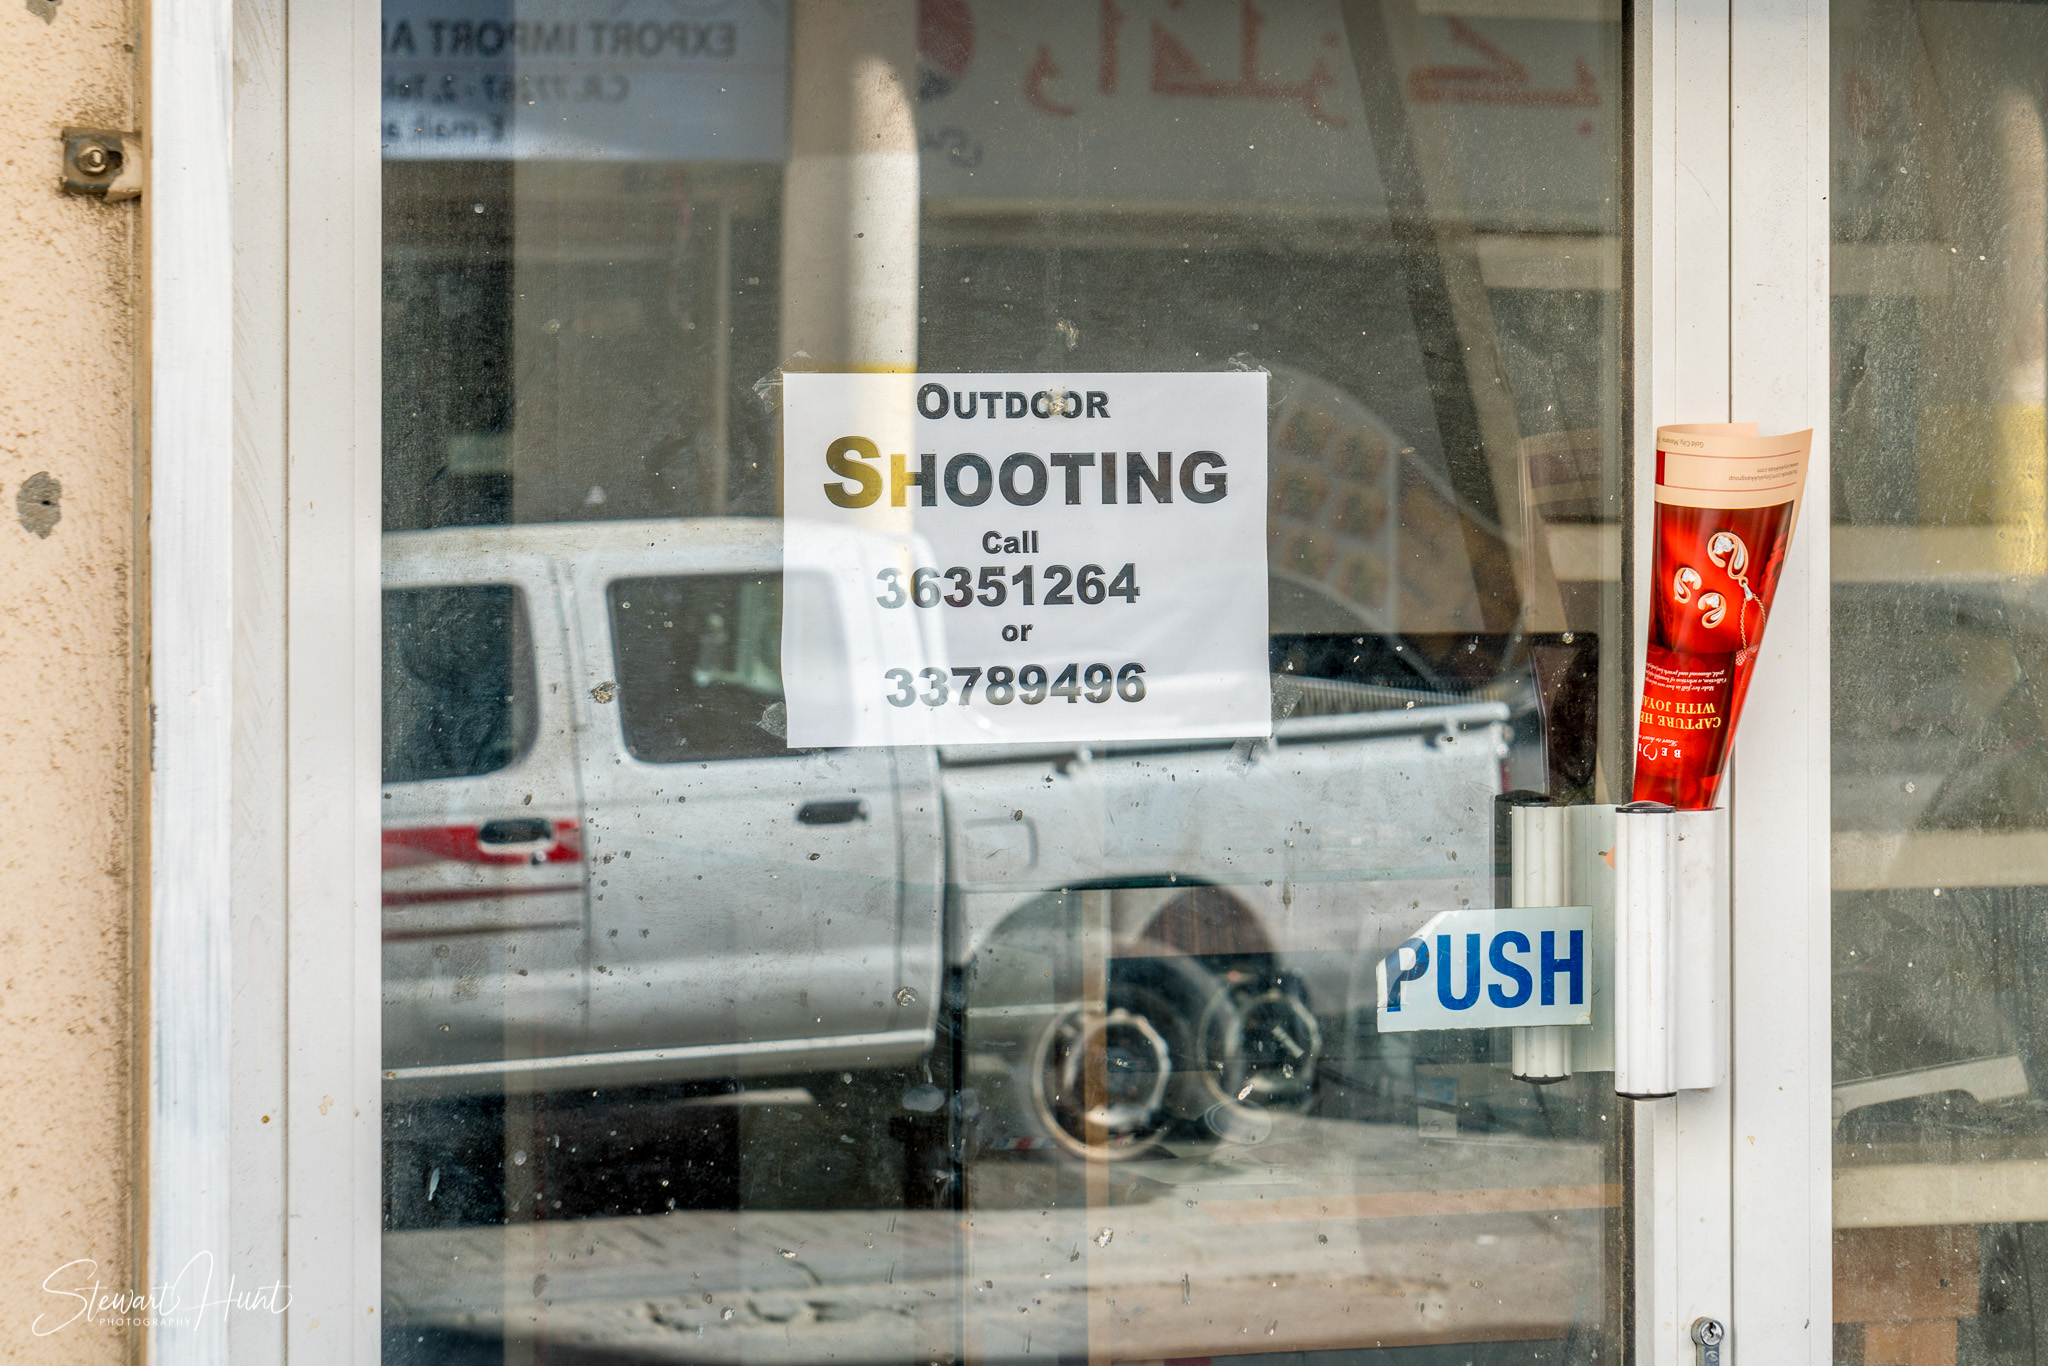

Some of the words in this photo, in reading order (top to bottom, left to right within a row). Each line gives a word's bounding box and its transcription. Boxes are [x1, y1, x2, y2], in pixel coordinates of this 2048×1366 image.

[916, 382, 1110, 420] OUTDOOR
[823, 435, 1229, 509] SHOOTING
[982, 530, 1039, 554] Call
[876, 563, 1141, 609] 36351264
[1001, 623, 1034, 642] or
[884, 662, 1147, 707] 33789496
[1657, 715, 1722, 730] CAPTURE
[1675, 702, 1716, 715] WITH
[1385, 929, 1584, 1013] PUSH
